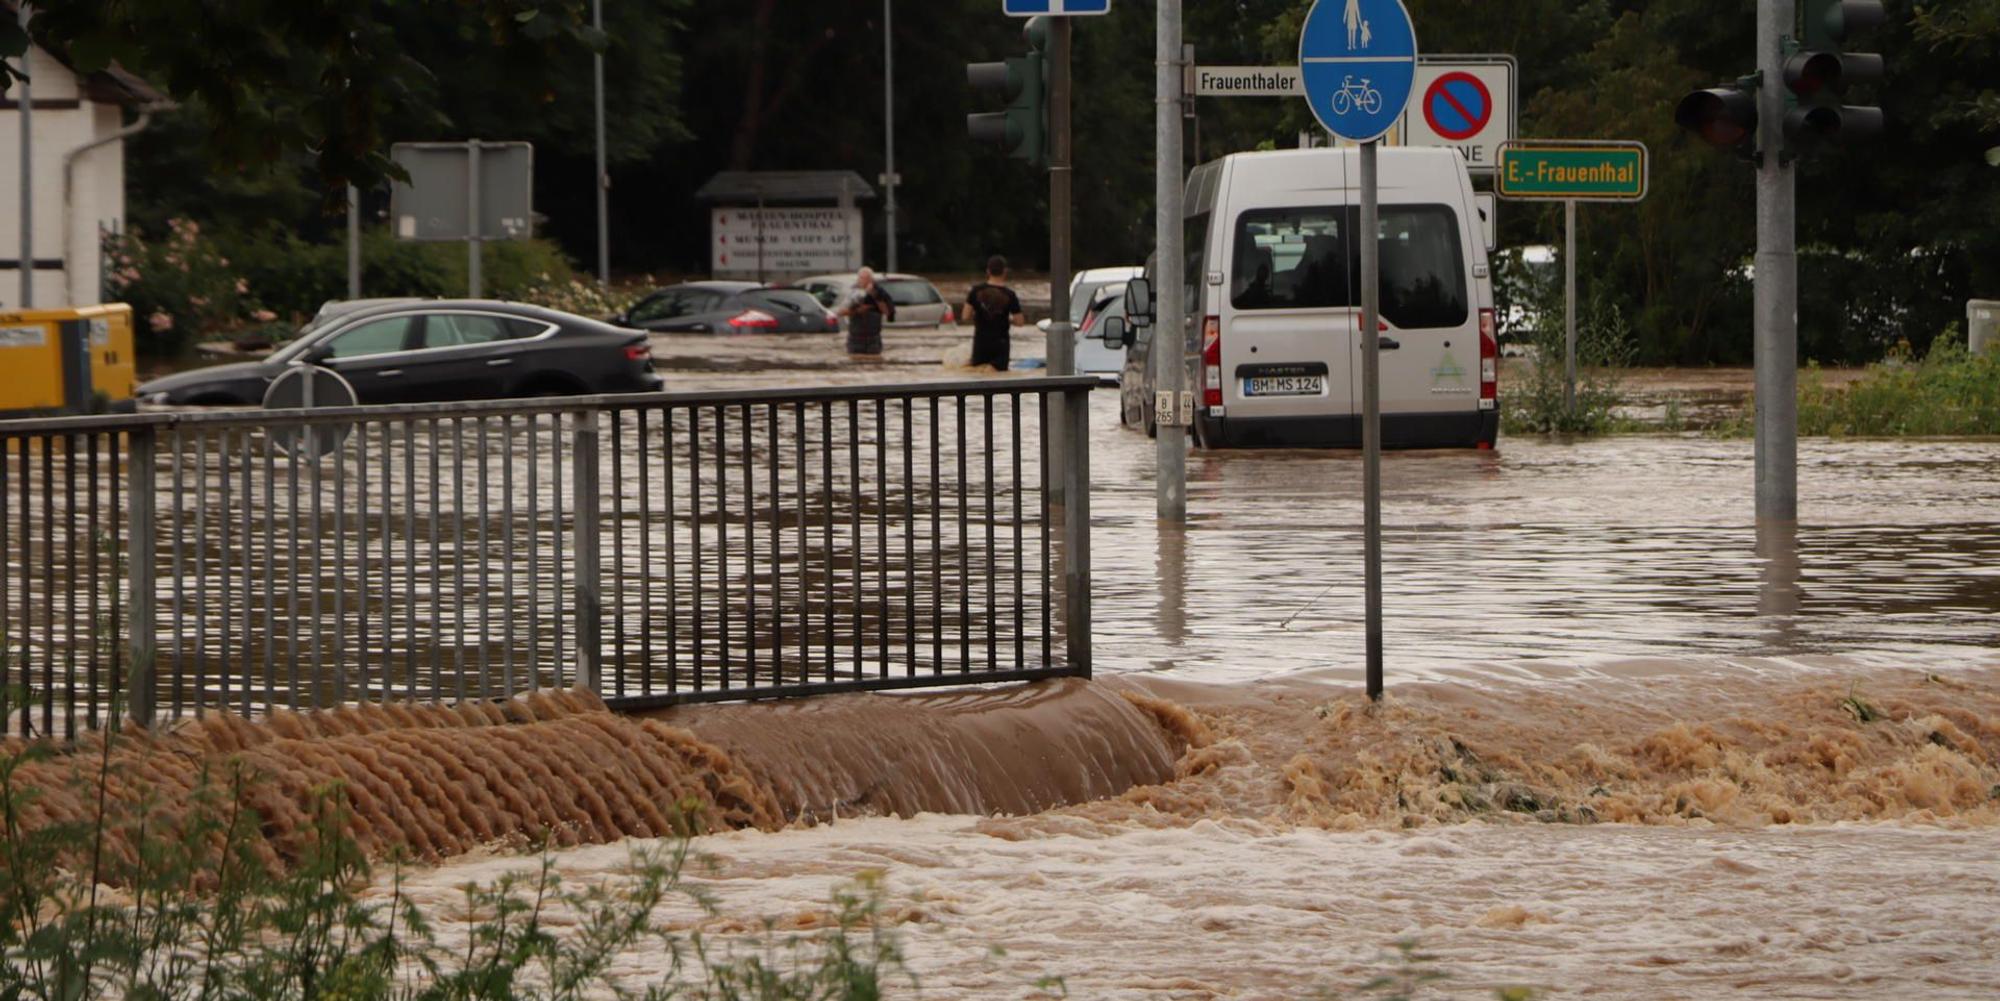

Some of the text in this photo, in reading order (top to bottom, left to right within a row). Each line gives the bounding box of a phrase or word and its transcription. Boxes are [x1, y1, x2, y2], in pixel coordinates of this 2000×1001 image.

[1201, 72, 1296, 90] Frauenthaler
[1252, 377, 1319, 392] BM MS 124
[1156, 411, 1173, 423] 265
